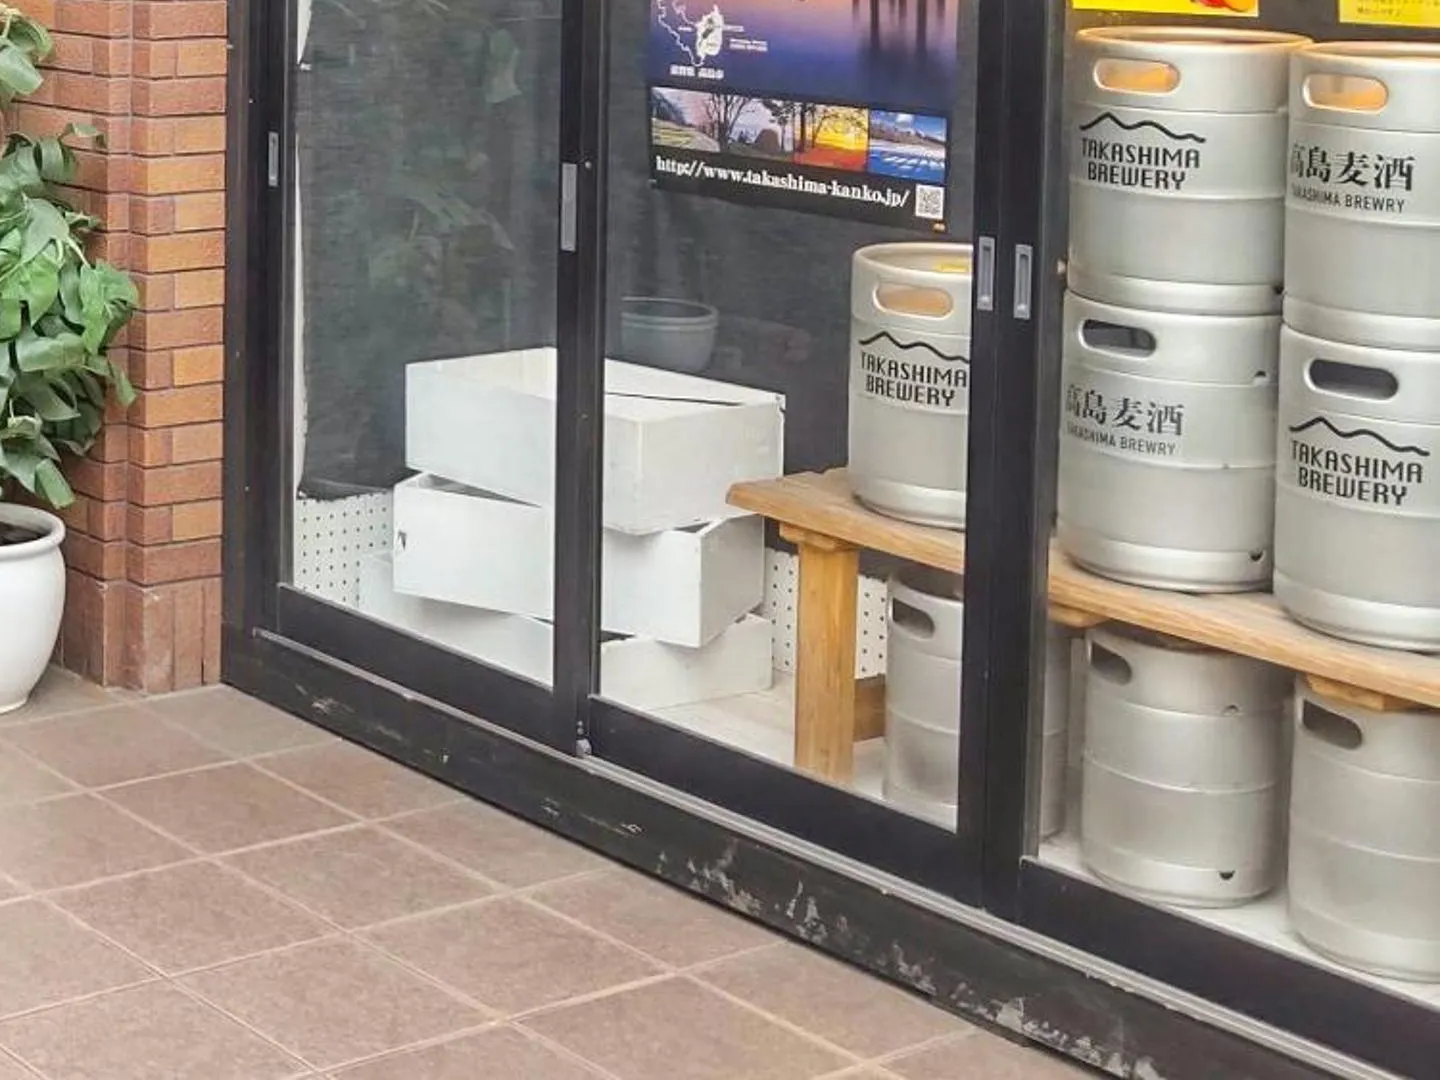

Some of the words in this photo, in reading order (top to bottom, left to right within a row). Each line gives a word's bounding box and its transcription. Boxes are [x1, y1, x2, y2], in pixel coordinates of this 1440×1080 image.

[1081, 137, 1201, 169] TAKASHIMA
[1087, 160, 1187, 191] BREWERY
[1344, 193, 1406, 213] BREWRY
[861, 351, 968, 388] TAKASHIMA
[865, 373, 956, 407] BREWERY
[1119, 435, 1177, 456] BREWRY
[1291, 439, 1424, 484] TAKASHIMA
[1297, 466, 1408, 506] BREWERY
